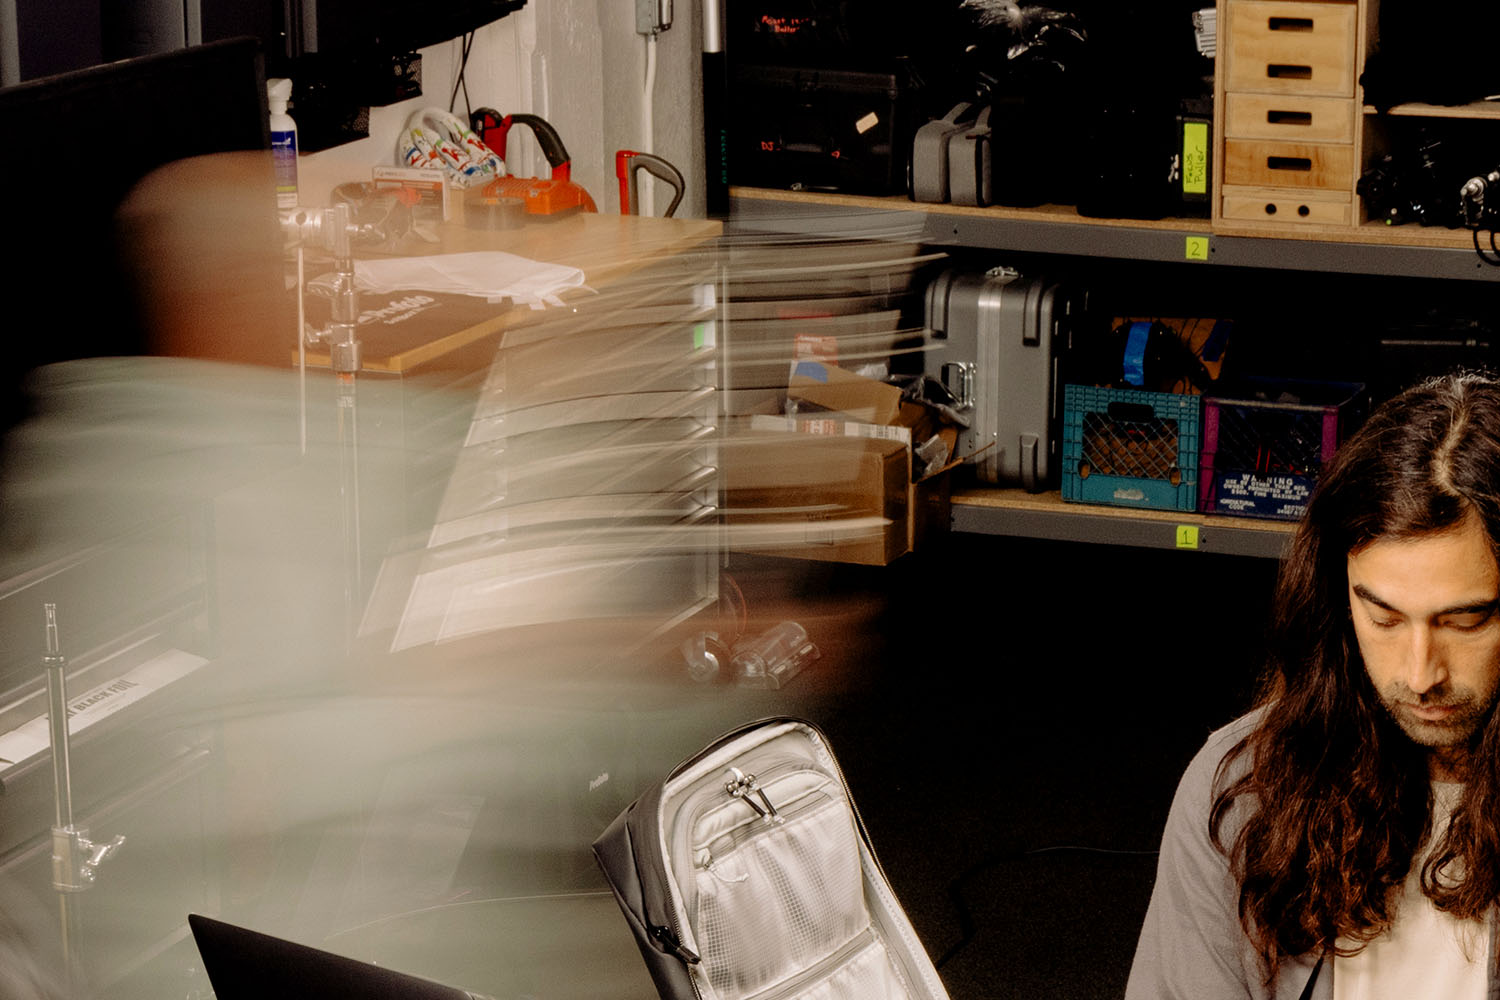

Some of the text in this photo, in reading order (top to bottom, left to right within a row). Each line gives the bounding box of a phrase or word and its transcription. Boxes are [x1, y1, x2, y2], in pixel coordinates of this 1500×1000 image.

[1194, 145, 1205, 184] Puller
[1191, 241, 1201, 257] 2
[1242, 473, 1294, 486] WANING
[1180, 530, 1193, 545] 1
[73, 691, 114, 711] BLACK
[108, 679, 140, 693] FOIL
